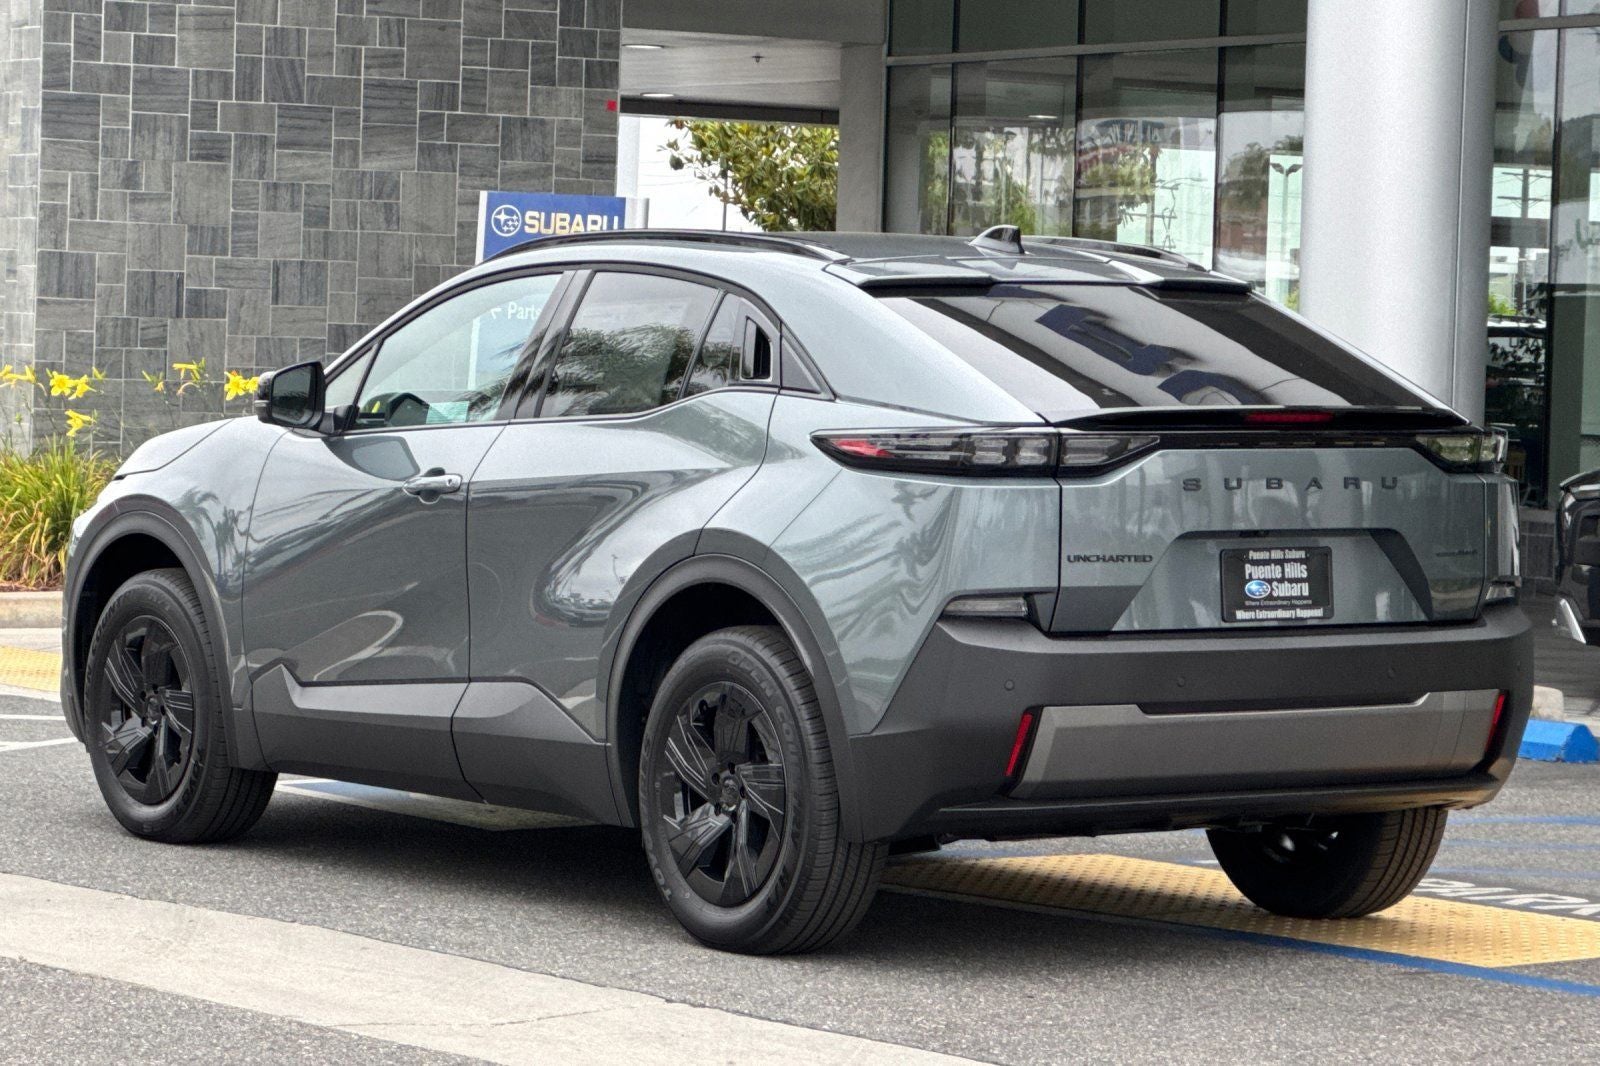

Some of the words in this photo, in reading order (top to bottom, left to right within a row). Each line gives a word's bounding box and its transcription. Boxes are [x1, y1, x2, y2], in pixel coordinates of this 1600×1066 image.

[524, 211, 618, 235] SUBARU
[507, 302, 541, 320] Parts
[1182, 476, 1398, 492] SUBARU
[1066, 554, 1153, 564] UNCHARTED
[1249, 550, 1270, 560] Puente
[1270, 549, 1284, 559] Hills
[1284, 549, 1306, 559] Subaru
[1244, 563, 1282, 579] Puente
[1284, 561, 1308, 579] Hills
[1271, 581, 1309, 597] Subaru
[1235, 609, 1256, 620] Where
[1256, 608, 1296, 619] Extraordinary
